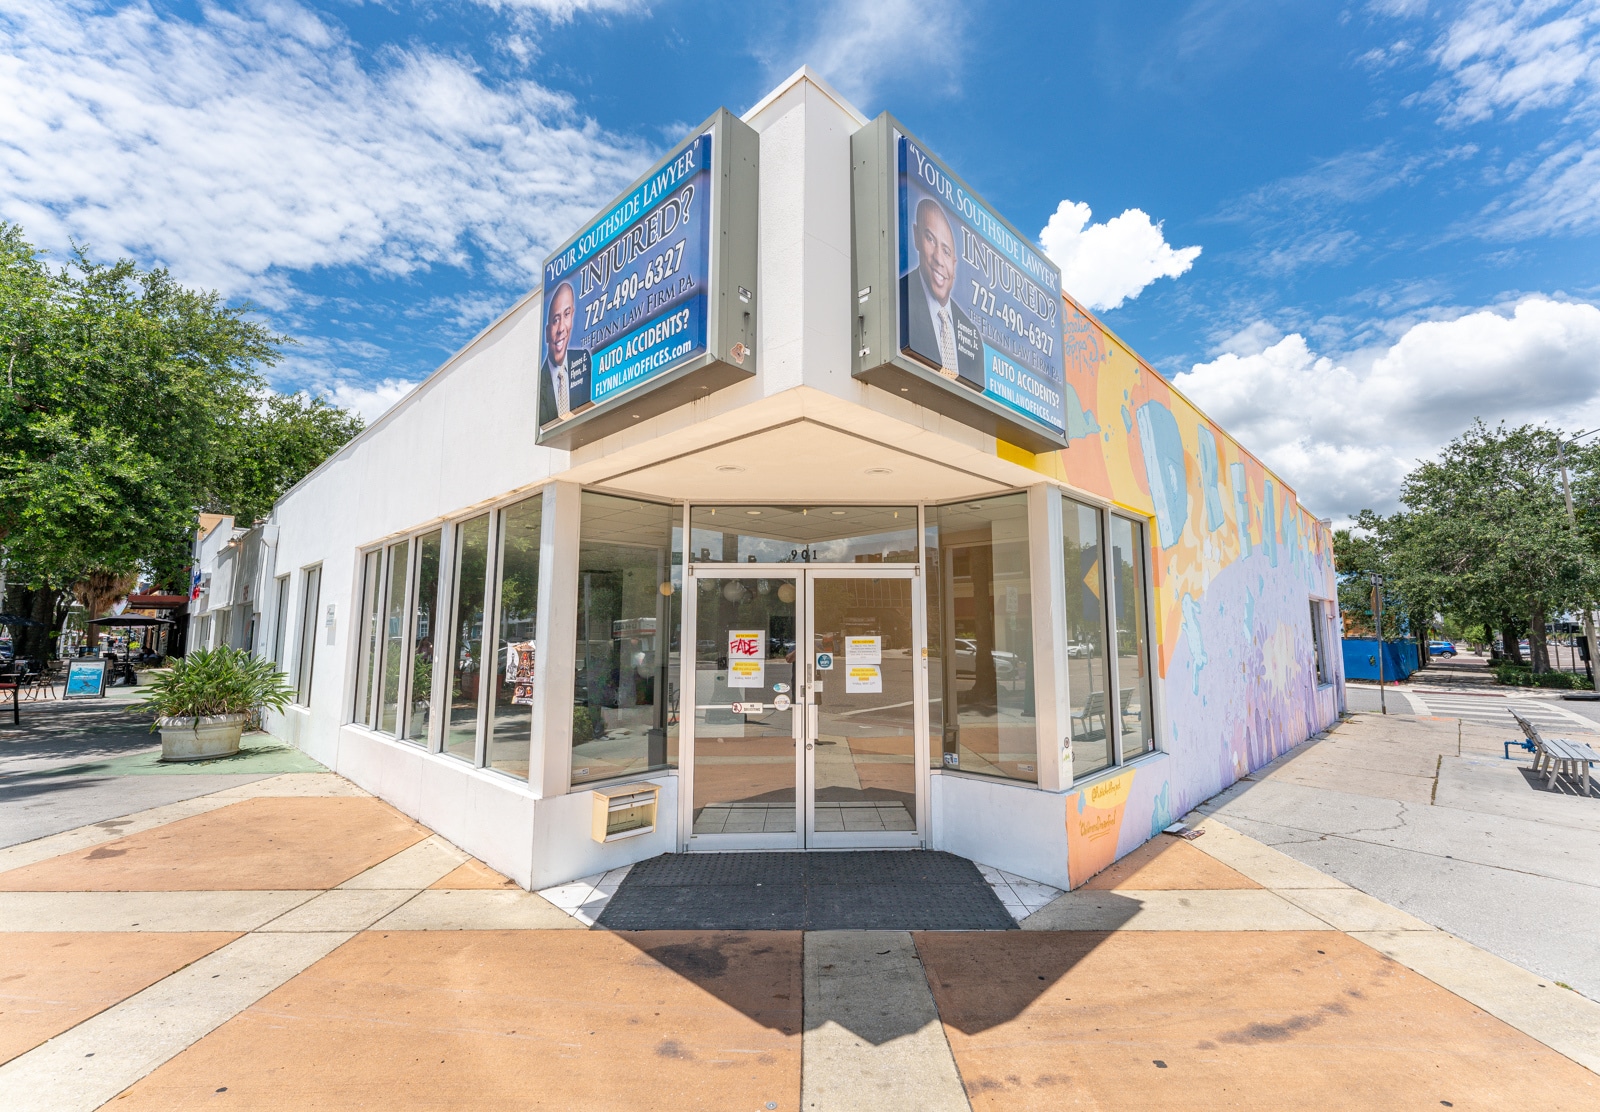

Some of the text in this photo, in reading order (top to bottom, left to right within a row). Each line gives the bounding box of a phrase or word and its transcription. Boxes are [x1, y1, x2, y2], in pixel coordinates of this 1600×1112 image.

[577, 194, 640, 260] SOUTHSIDE
[579, 184, 695, 300] INJURED?
[956, 188, 1019, 260] SOUTHSIDE
[584, 238, 687, 331] 727-490-6327
[961, 225, 1057, 328] INJURED?
[590, 317, 621, 350] FLYNN
[622, 302, 645, 330] LAW
[647, 284, 676, 316] FIRM
[598, 308, 690, 375] AUTO ACCIDENTS?
[958, 319, 973, 337] James
[971, 279, 1054, 357] 727-490-6327
[981, 316, 1011, 350] FLYNN
[1012, 340, 1032, 363] LAW
[1033, 351, 1052, 377] FIRM
[571, 357, 583, 370] James
[595, 340, 692, 397] FLYNNLAWOFFICES.com
[958, 342, 975, 360] Attorney
[989, 378, 1063, 428] FLYNNLAWOFFICES.com
[992, 355, 1060, 409] AUTO ACCIDENTS?
[791, 549, 818, 560] 901
[730, 638, 759, 656] FADE
